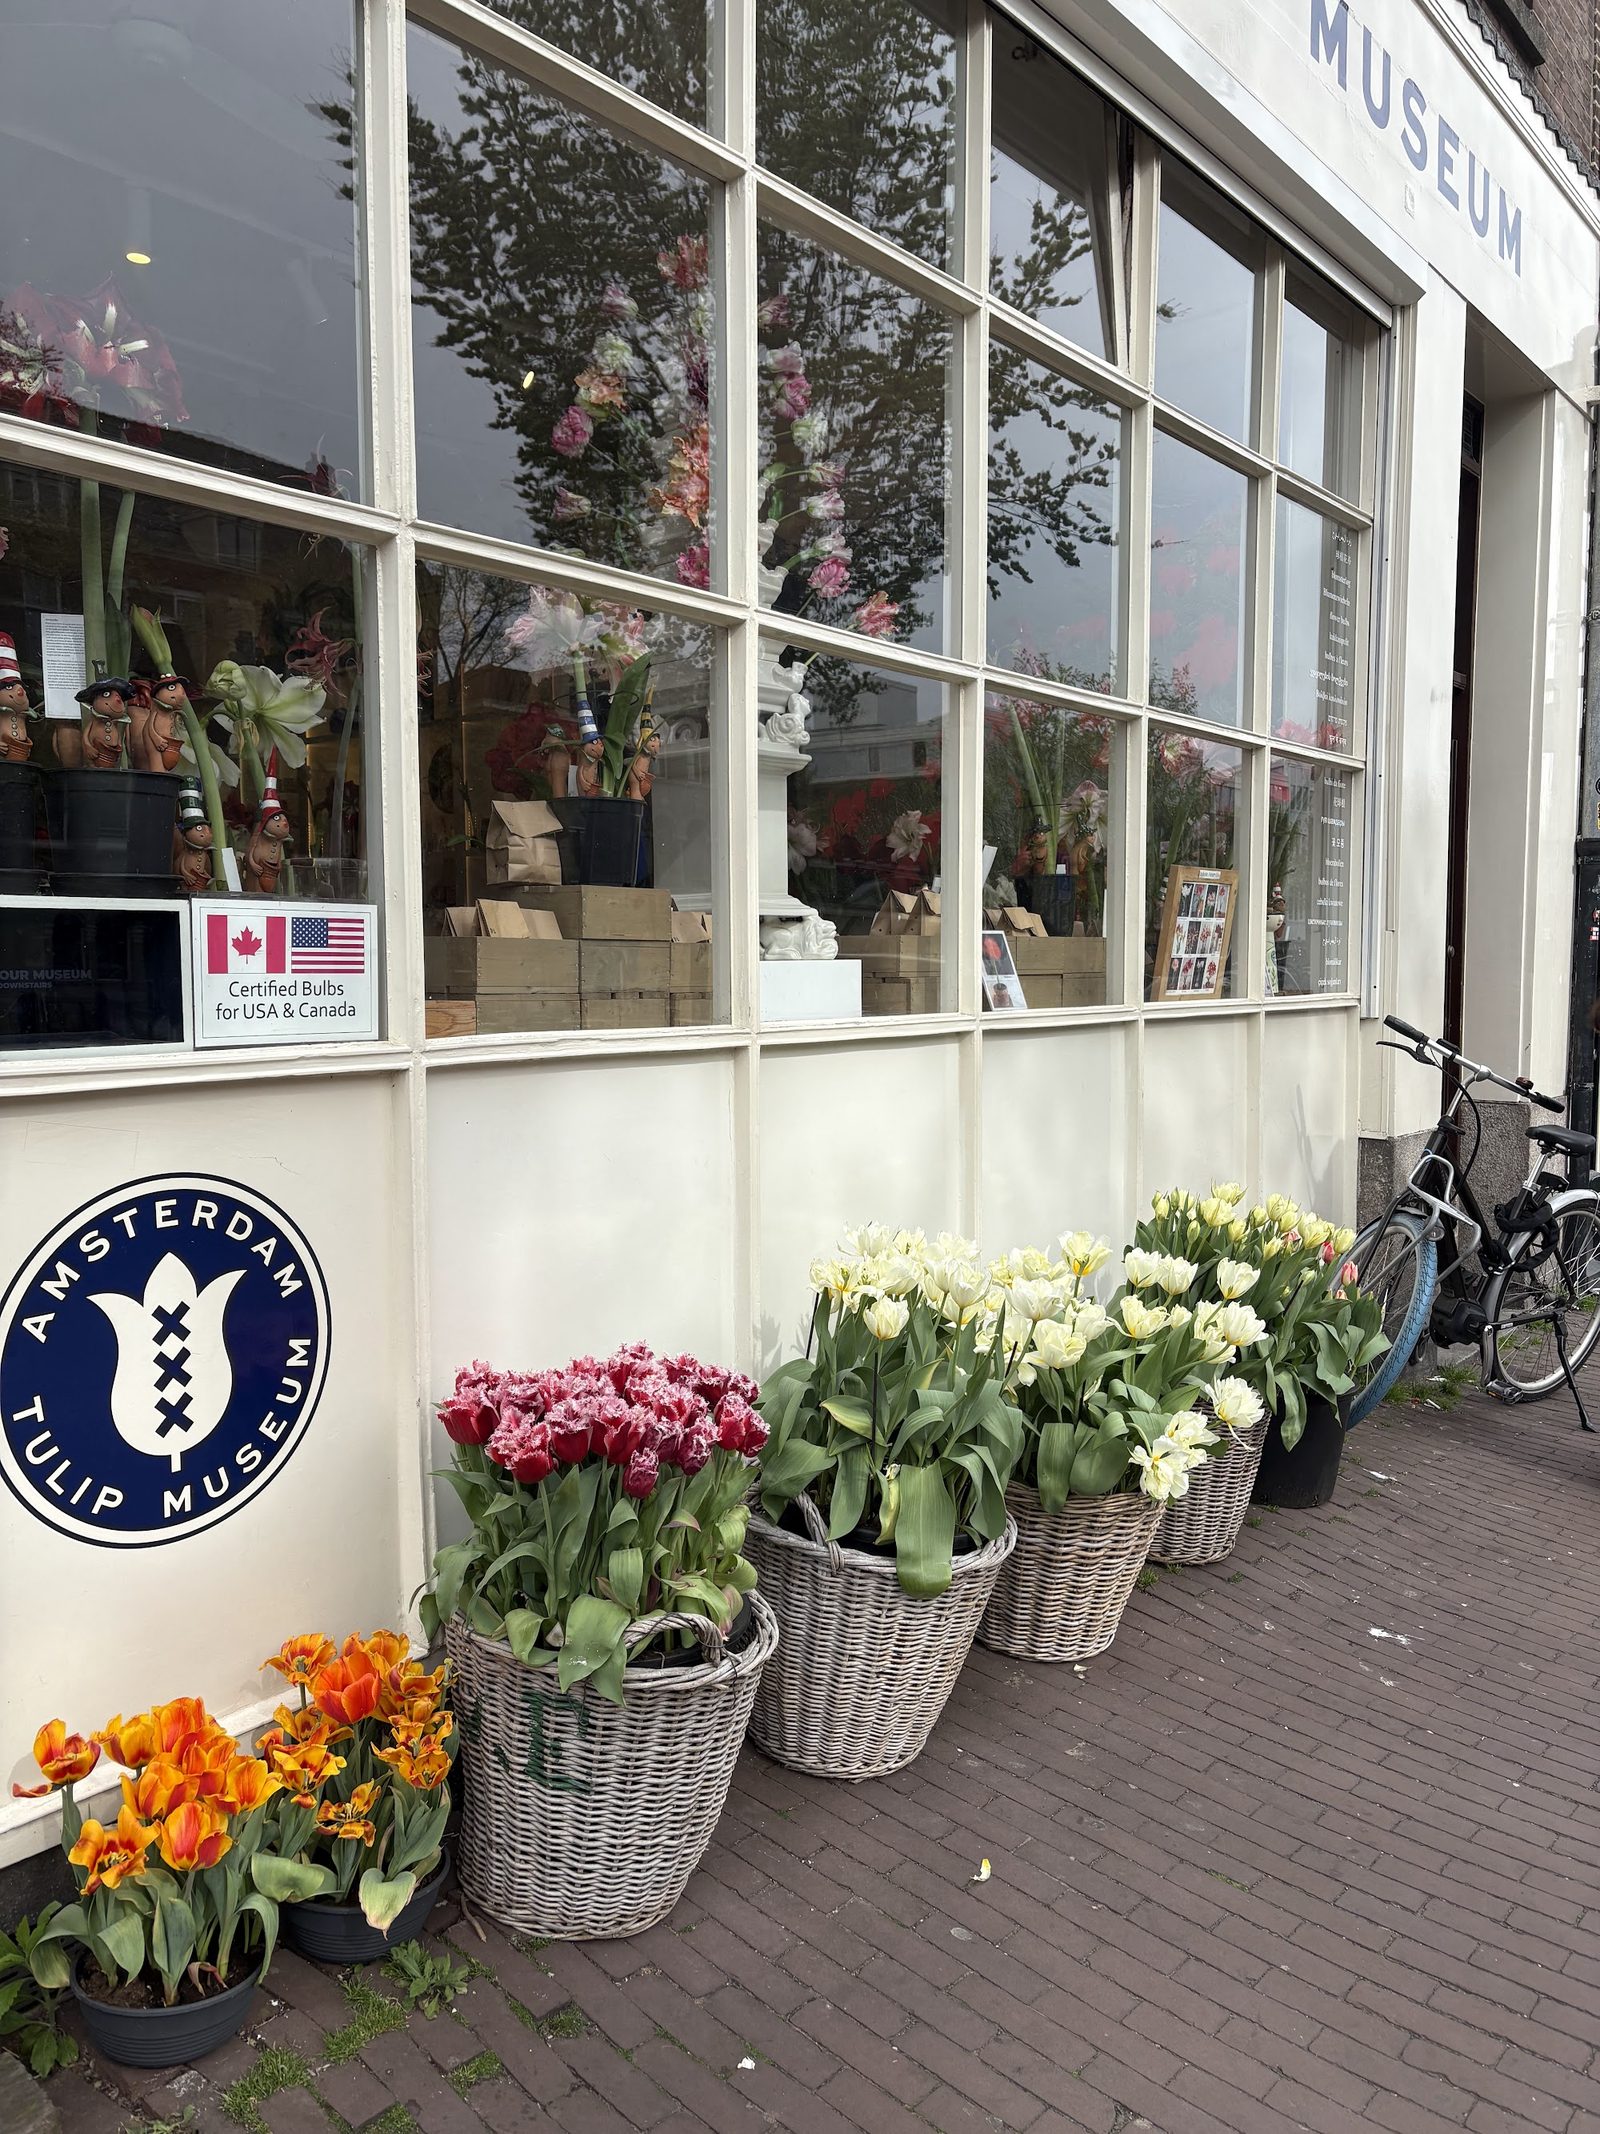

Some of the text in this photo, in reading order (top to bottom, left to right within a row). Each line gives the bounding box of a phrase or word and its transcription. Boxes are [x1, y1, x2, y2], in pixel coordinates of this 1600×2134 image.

[1310, 0, 1522, 278] MUSEUM
[33, 968, 93, 980] MUSEUM
[216, 1001, 356, 1020] for USA & Canada
[229, 979, 345, 998] Certified Bulbs
[21, 1198, 303, 1344] AMSTERDAM
[12, 1338, 312, 1518] TULIP MUSEUM
